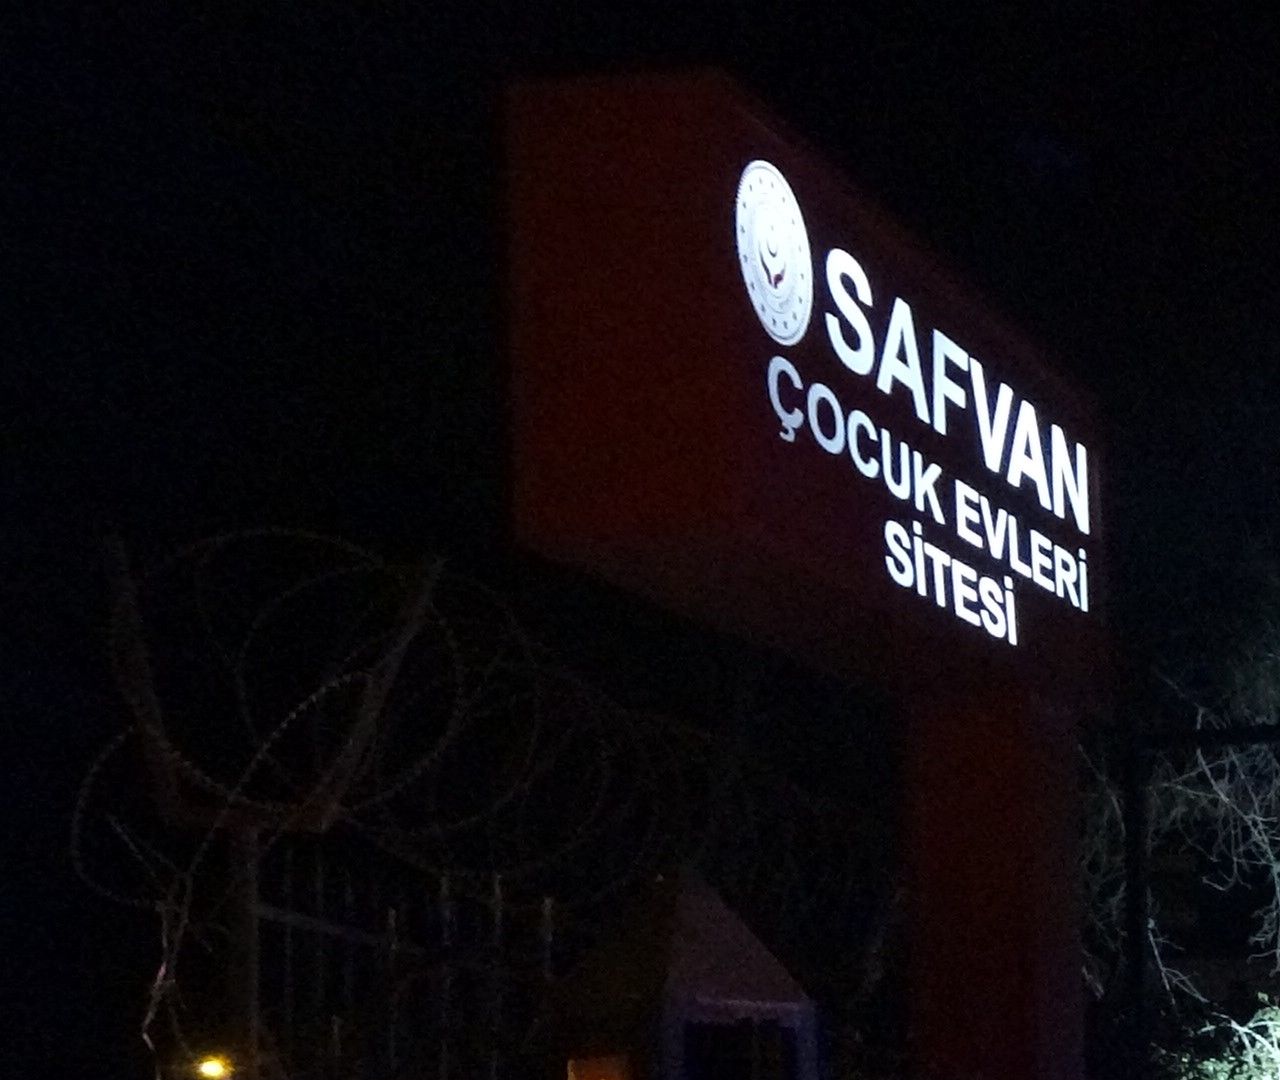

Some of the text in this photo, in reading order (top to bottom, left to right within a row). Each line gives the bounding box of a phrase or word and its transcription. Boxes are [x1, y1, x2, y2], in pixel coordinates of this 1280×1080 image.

[767, 355, 1088, 612] ÇOCUK EVLERİ
[826, 248, 1090, 534] SAFVAN
[885, 514, 1018, 646] SİTESİ
